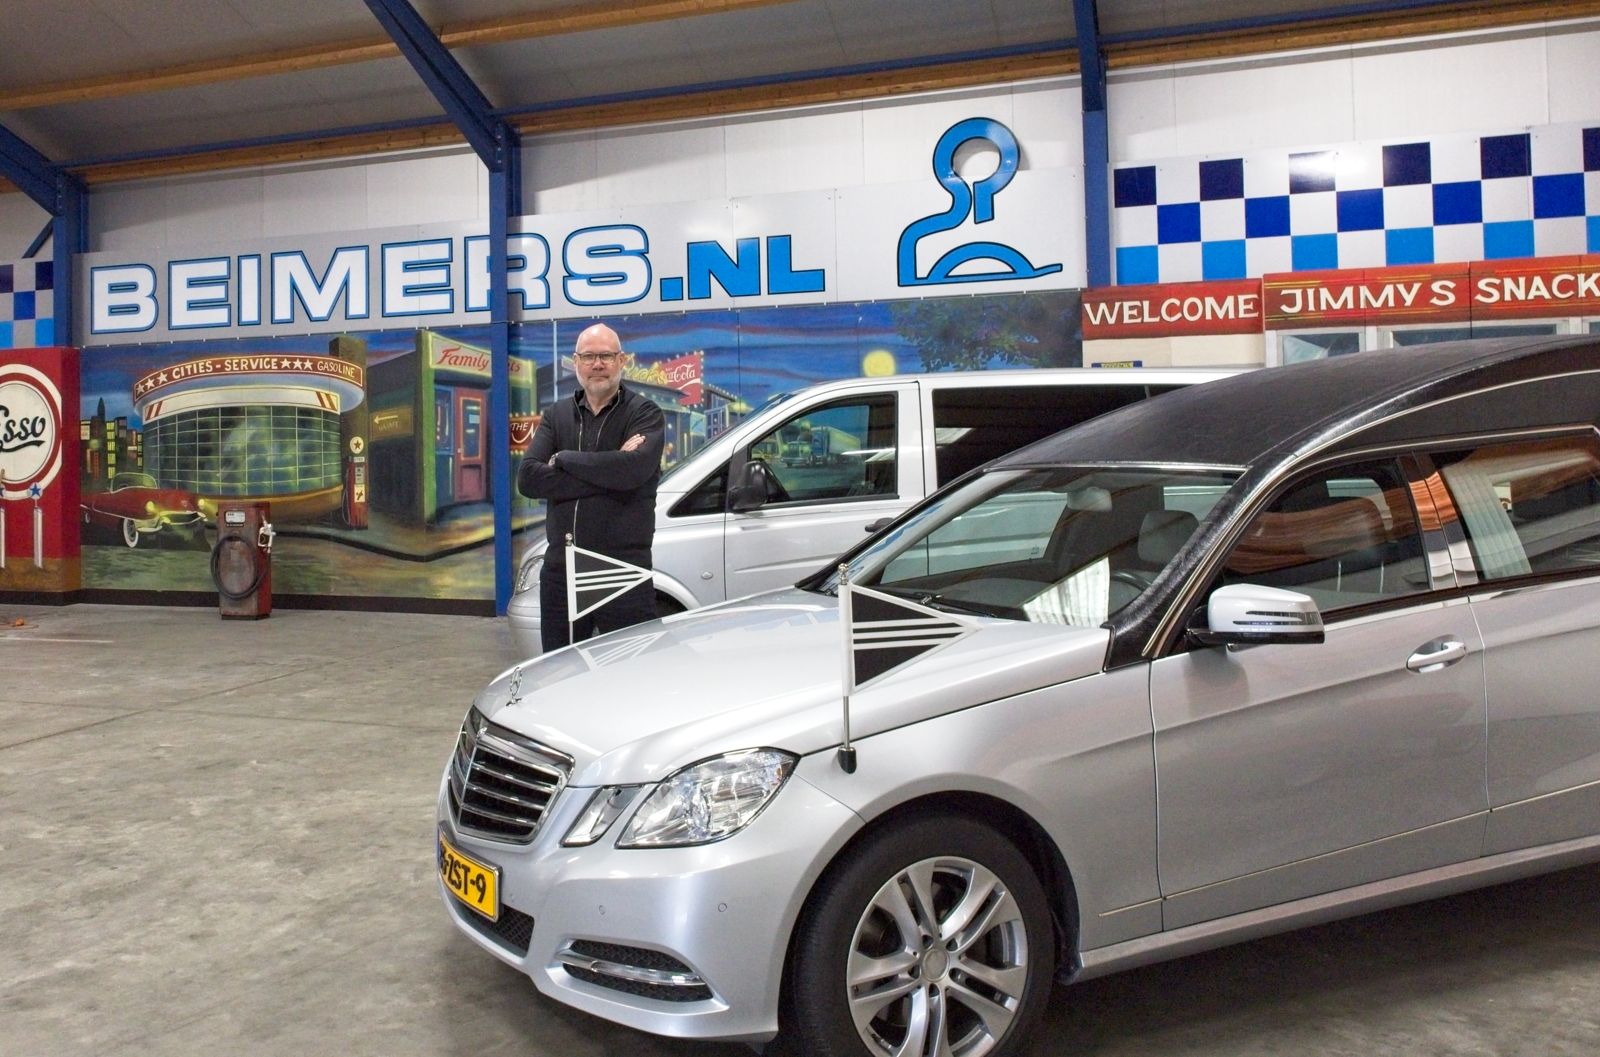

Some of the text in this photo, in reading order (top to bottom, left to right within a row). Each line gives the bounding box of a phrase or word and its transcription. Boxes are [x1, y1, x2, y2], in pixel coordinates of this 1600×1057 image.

[1474, 272, 1600, 304] SNACK
[1084, 294, 1259, 326] WELCOME
[172, 359, 214, 380] CITIES
[224, 357, 278, 372] SERVICE
[317, 361, 356, 379] GASOLINE
[437, 346, 490, 371] Family
[510, 422, 529, 431] THE
